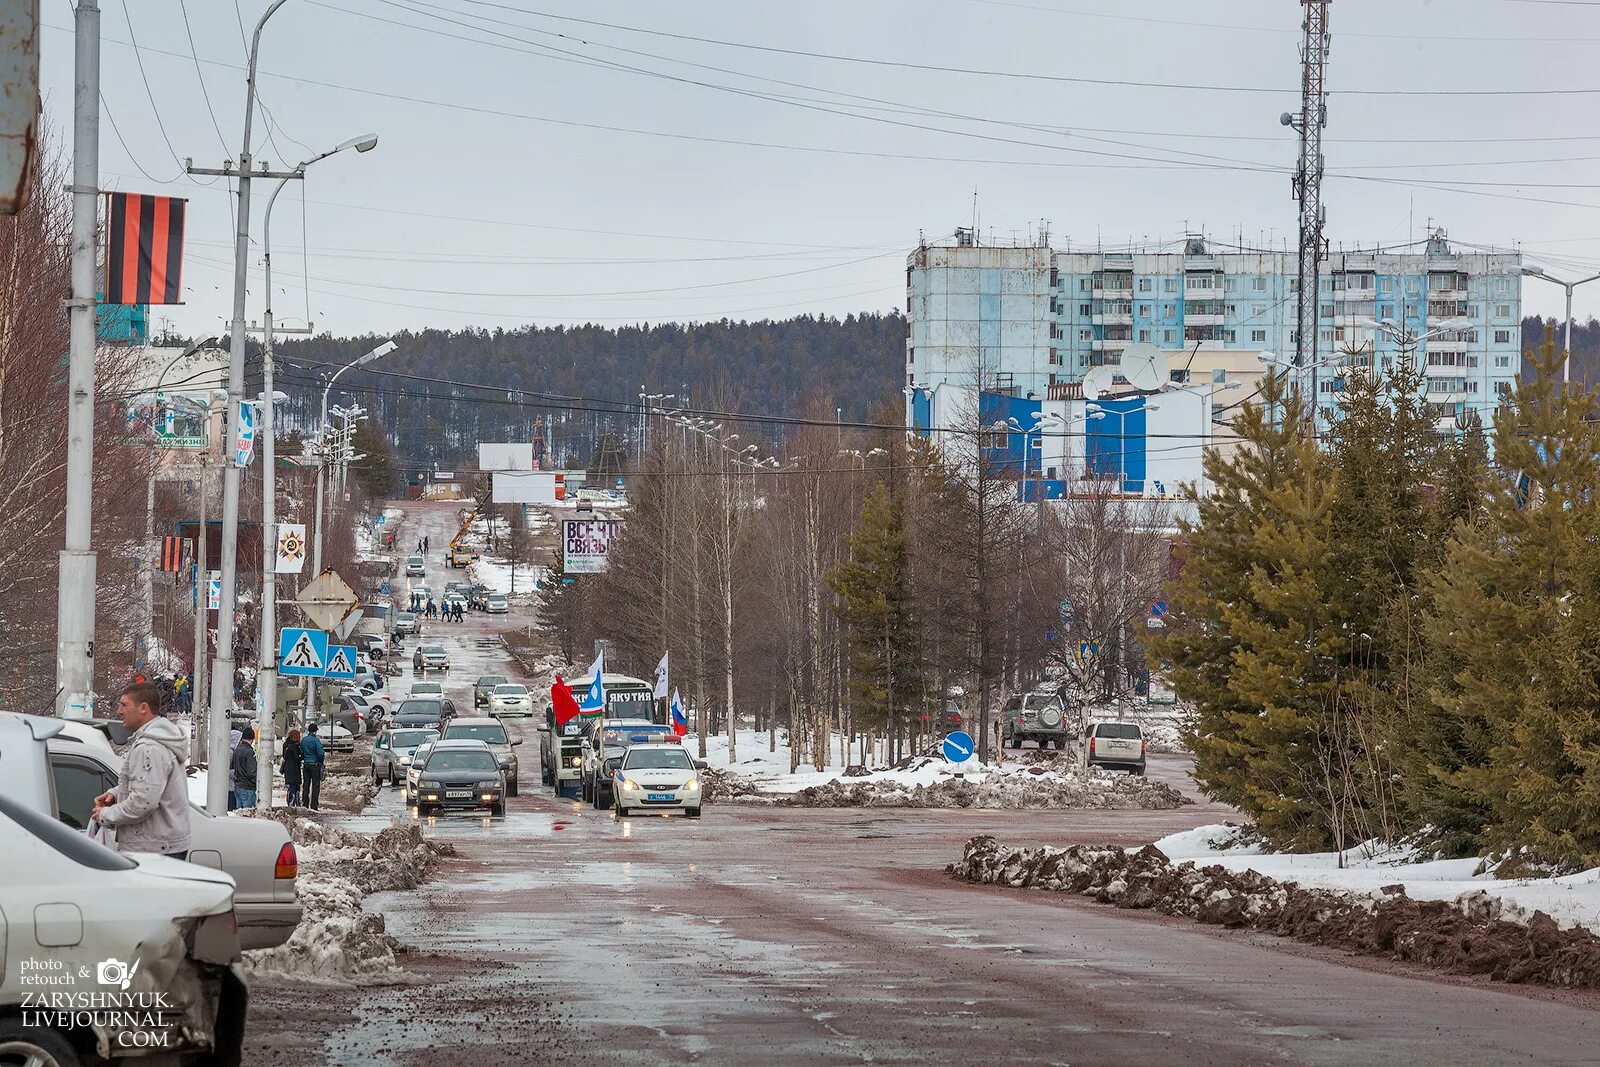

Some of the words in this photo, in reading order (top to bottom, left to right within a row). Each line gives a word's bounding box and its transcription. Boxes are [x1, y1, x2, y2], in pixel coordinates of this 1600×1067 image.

[567, 522, 594, 538] ВСЕ
[609, 692, 651, 702] ЯКУТИЯ
[225, 709, 231, 719] 3
